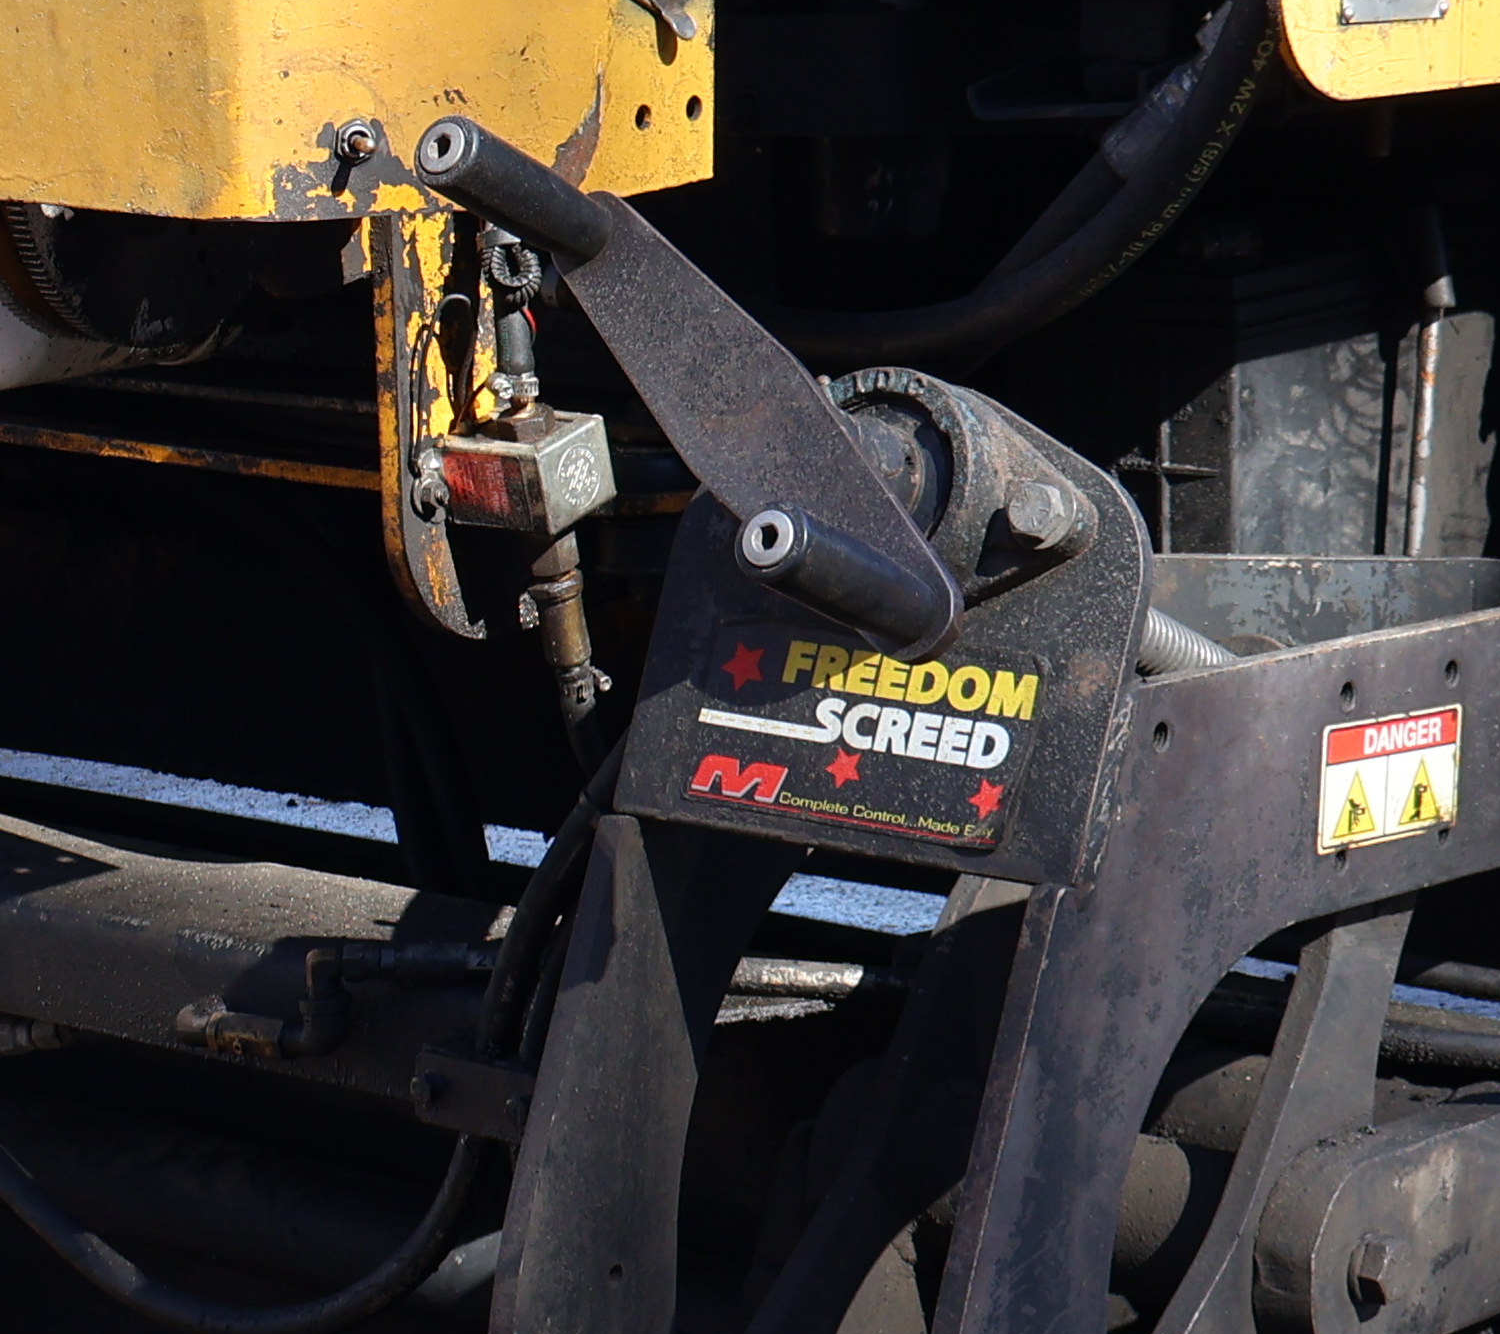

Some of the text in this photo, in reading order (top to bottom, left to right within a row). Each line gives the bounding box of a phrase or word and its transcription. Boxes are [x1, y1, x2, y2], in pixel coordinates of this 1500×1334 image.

[781, 640, 1039, 720] FREEDOM
[814, 698, 1010, 769] SCREED
[1363, 717, 1442, 755] DANGER
[779, 791, 849, 817] Complete
